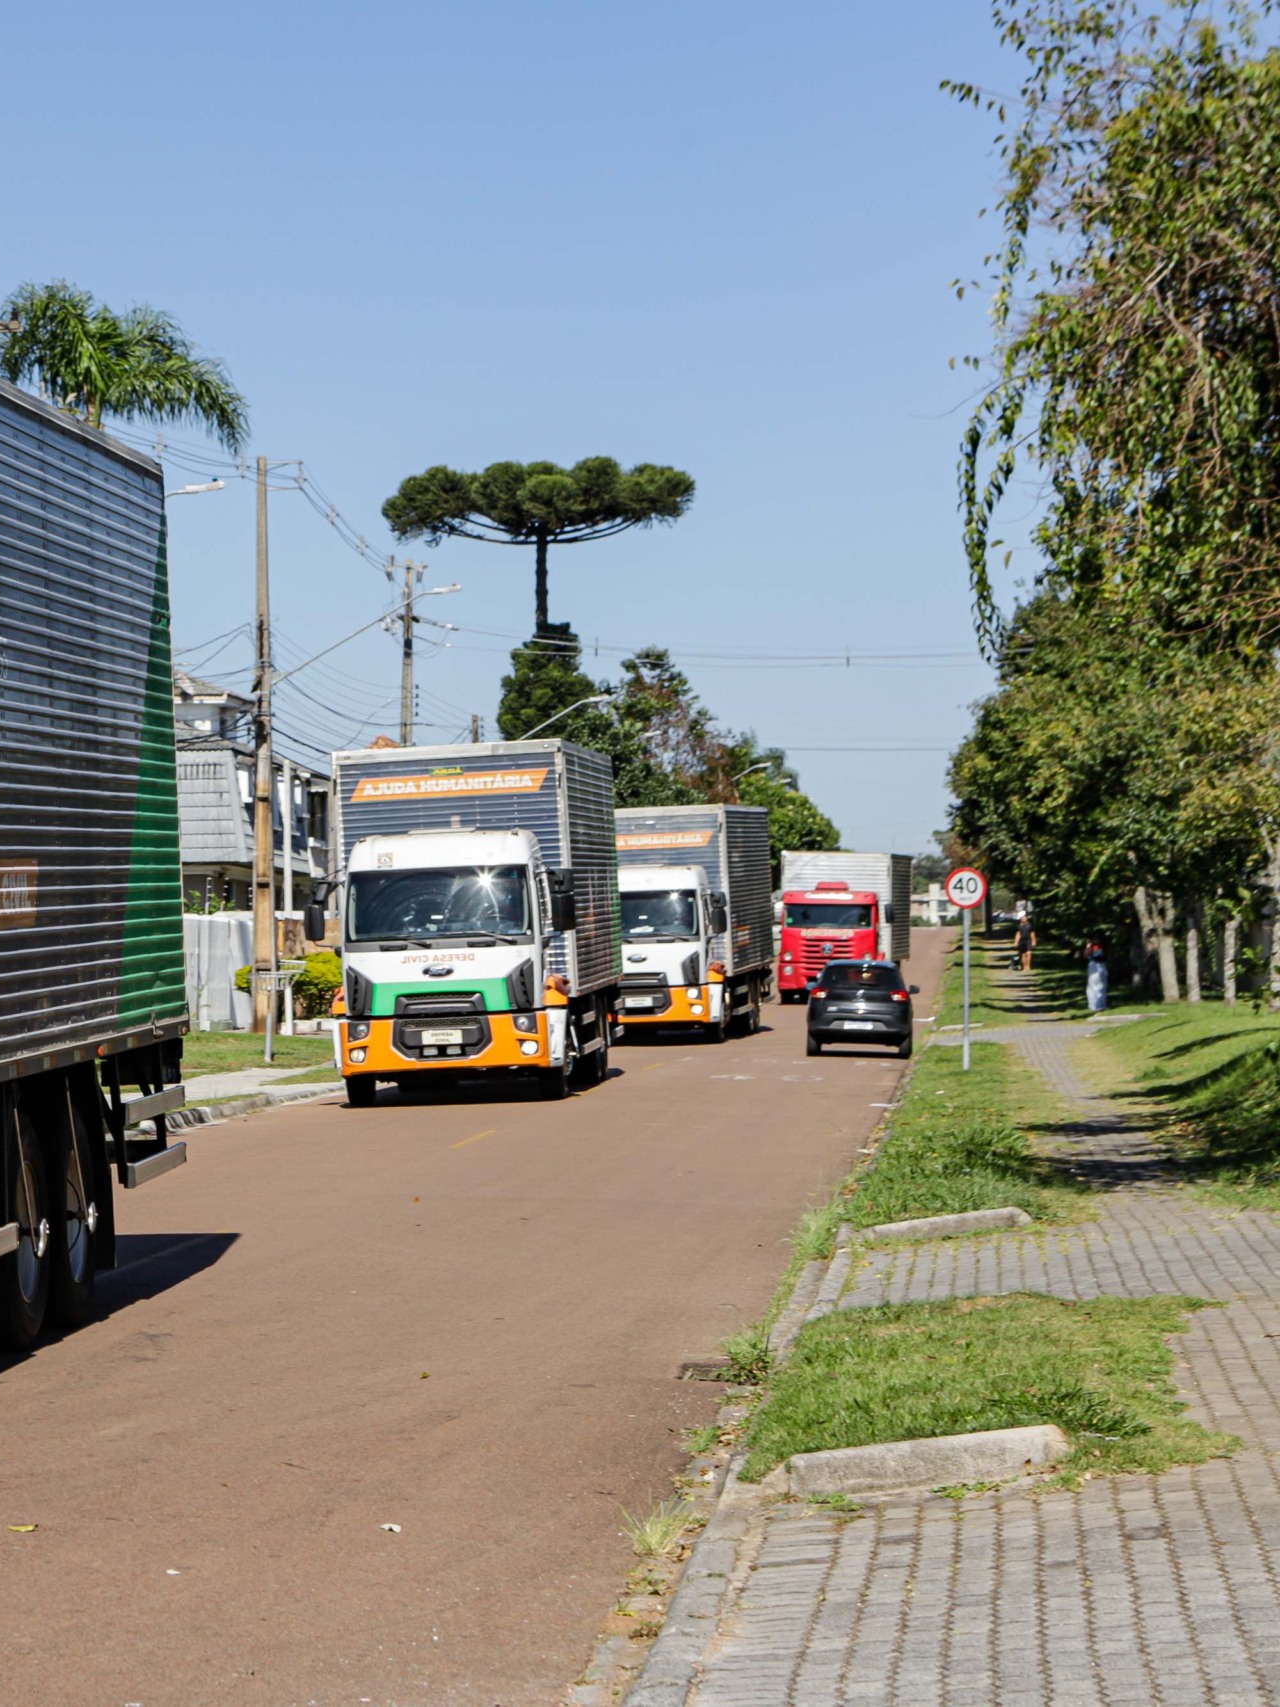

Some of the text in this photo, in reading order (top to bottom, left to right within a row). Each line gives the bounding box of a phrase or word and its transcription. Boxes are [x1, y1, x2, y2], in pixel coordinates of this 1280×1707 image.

[363, 774, 533, 797] AJUDA HUMANITÁRIA
[1, 872, 32, 915] CIVIL
[953, 877, 978, 894] 40
